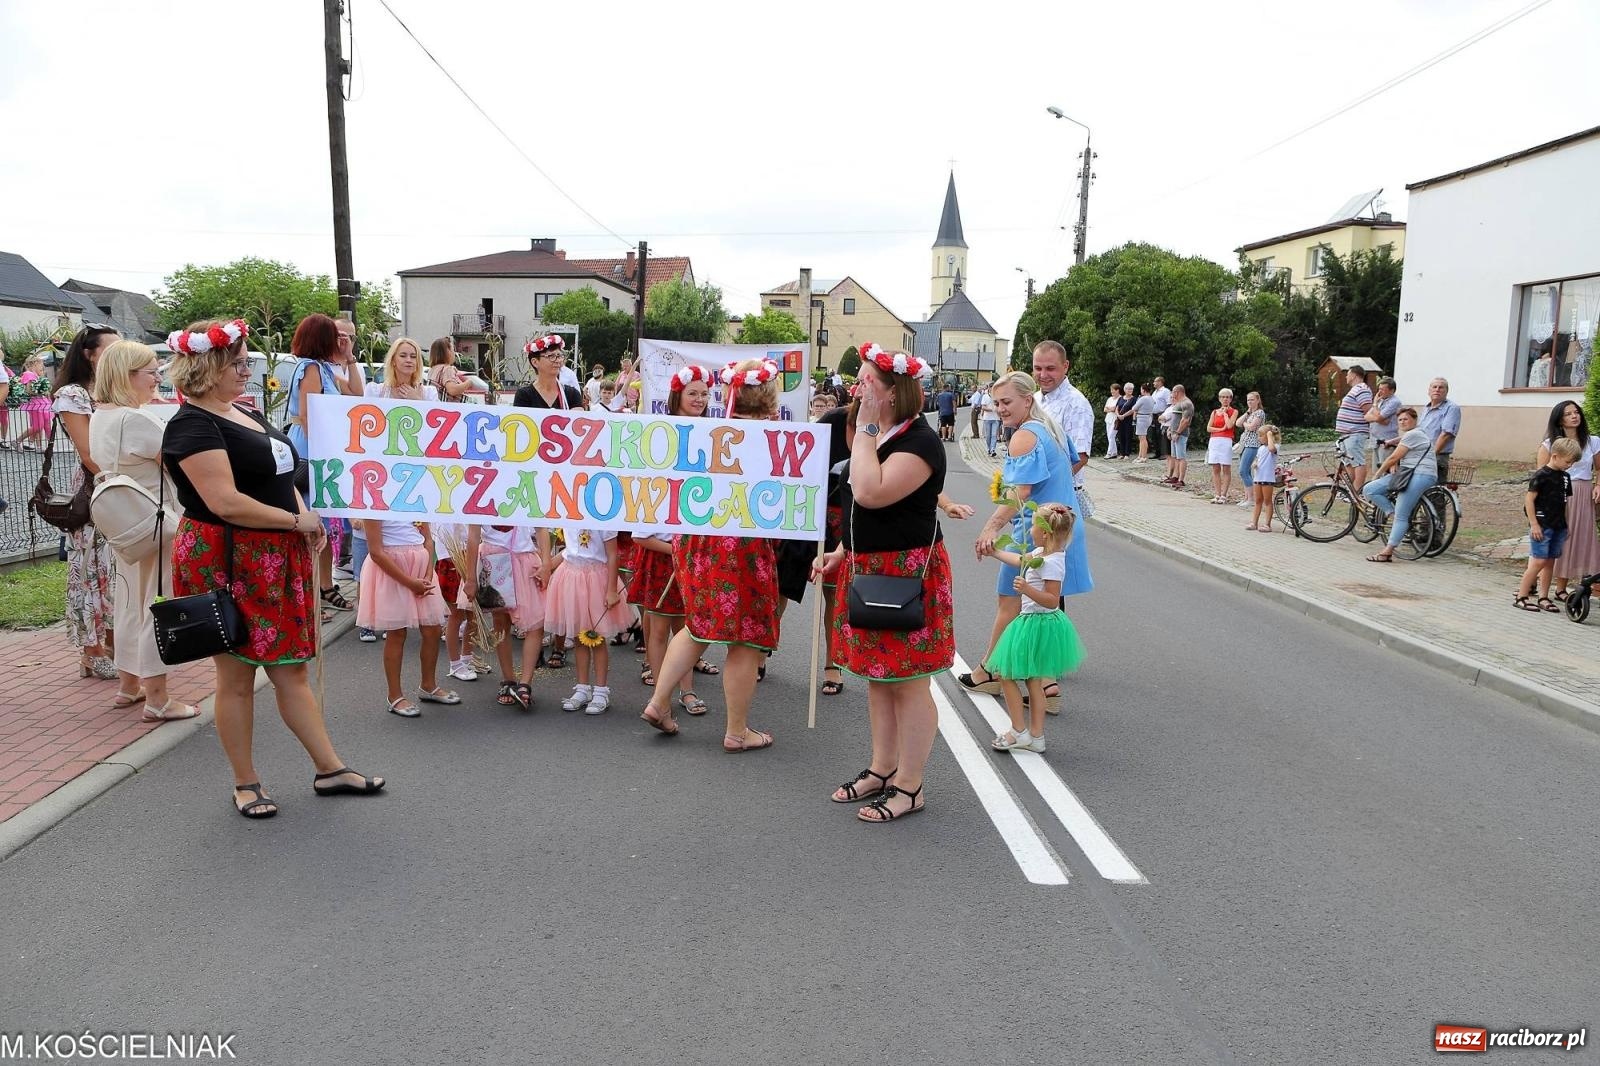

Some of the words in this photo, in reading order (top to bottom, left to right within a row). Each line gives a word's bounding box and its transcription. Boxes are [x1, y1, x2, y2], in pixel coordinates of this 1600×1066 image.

[1403, 312, 1414, 322] 32
[346, 404, 744, 475] PRZEDSZKOLE
[764, 429, 815, 478] W
[309, 458, 821, 532] KRZYŻANOWICACH
